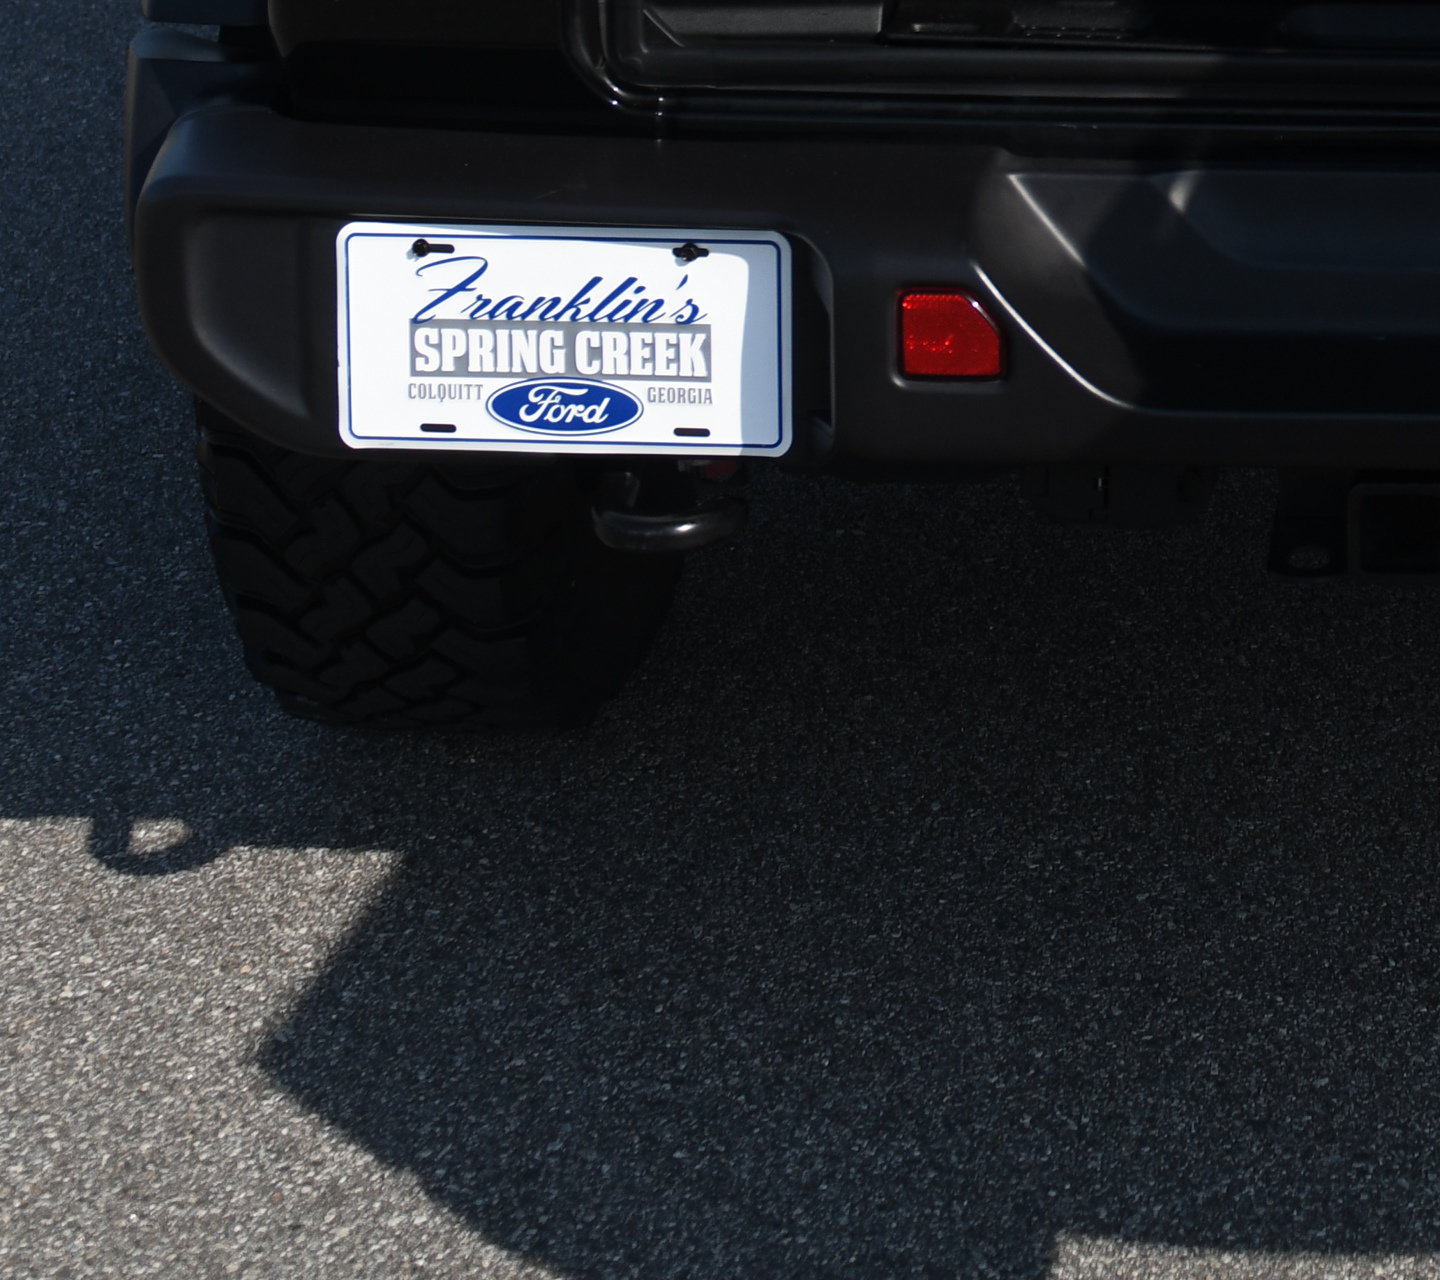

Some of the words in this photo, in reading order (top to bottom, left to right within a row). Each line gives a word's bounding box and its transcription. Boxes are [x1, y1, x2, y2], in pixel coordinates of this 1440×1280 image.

[412, 255, 709, 325] Franklin's
[413, 327, 568, 375] SPRING
[575, 331, 709, 378] CREEK
[407, 383, 484, 403] COLQUITT
[517, 384, 610, 426] Ford
[646, 386, 714, 406] GEORGIA
